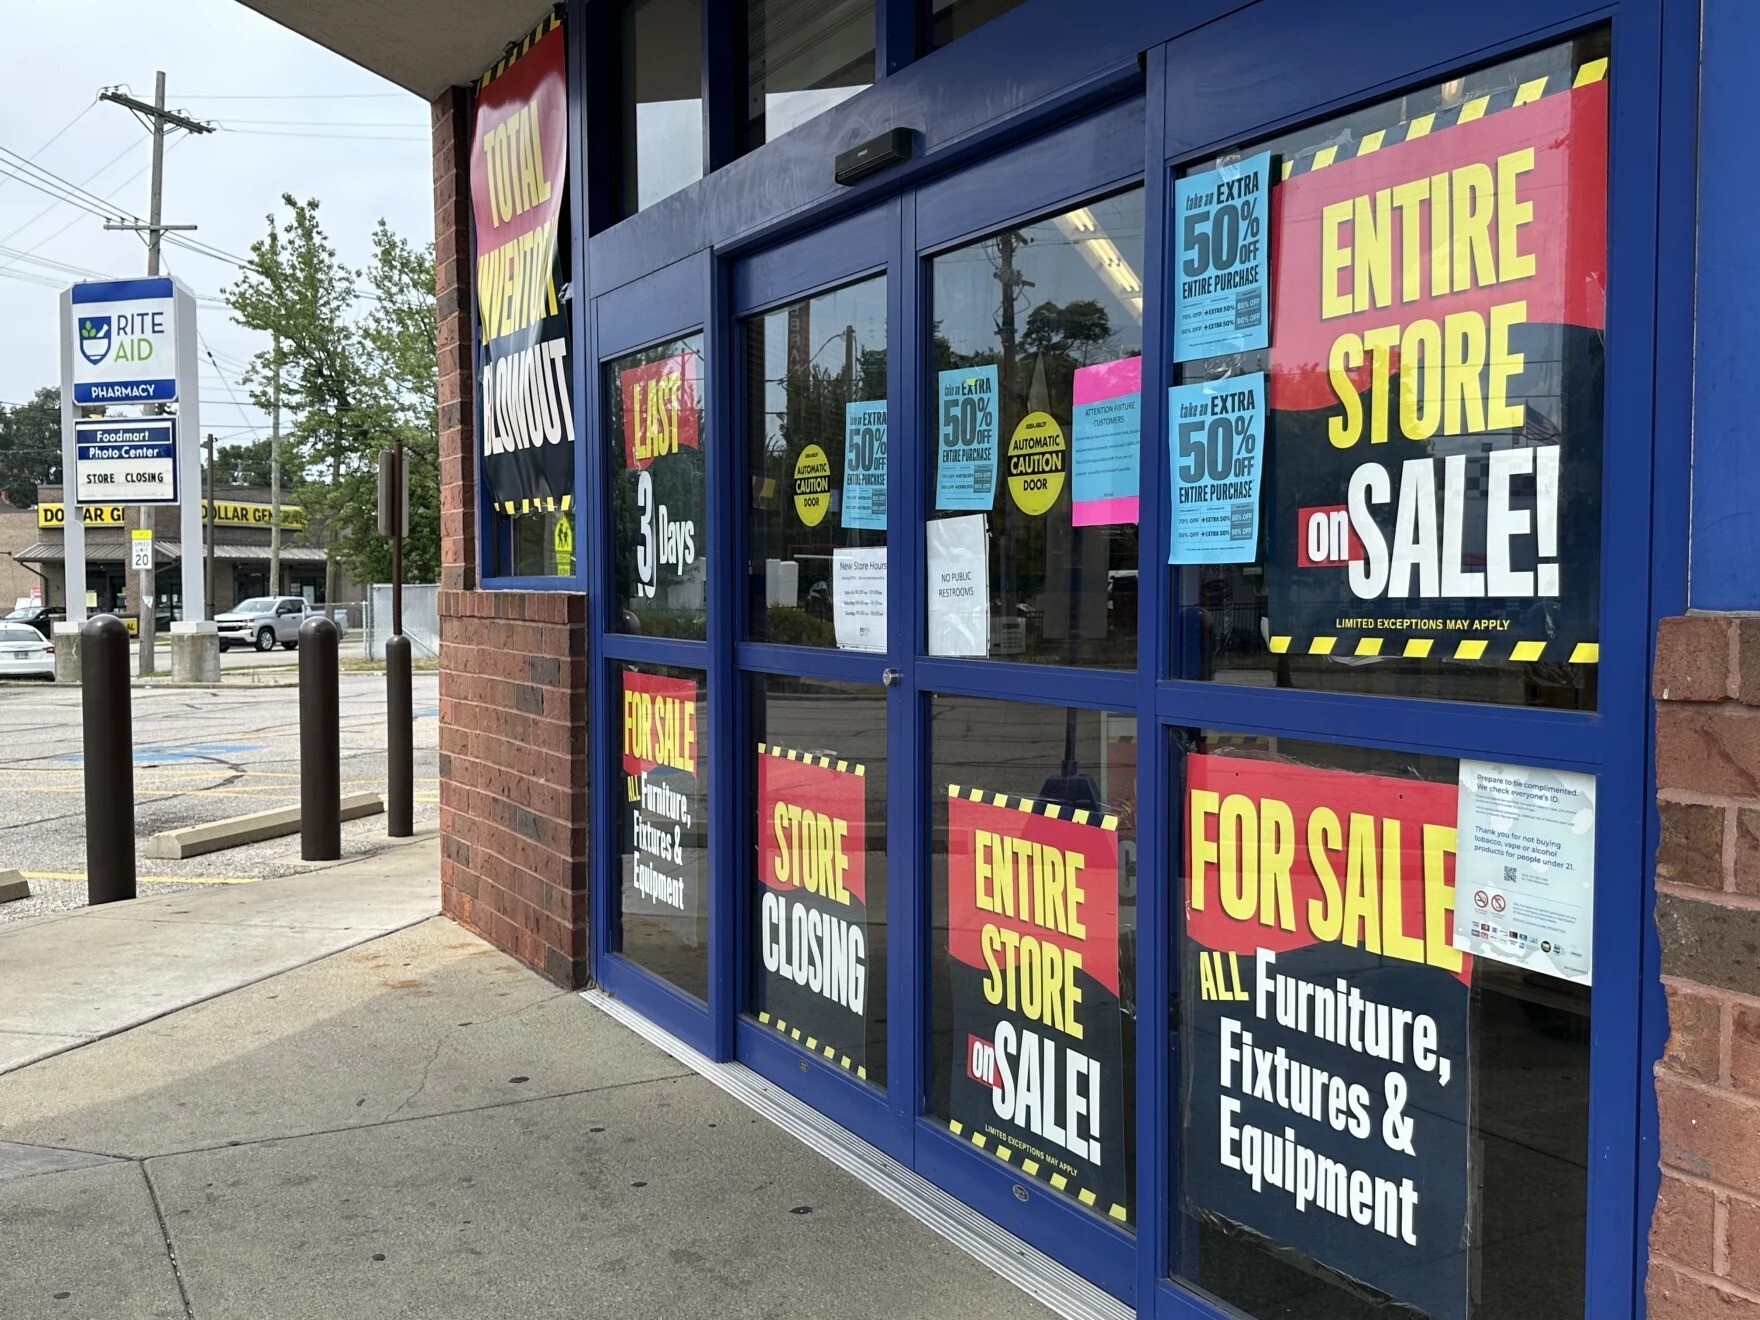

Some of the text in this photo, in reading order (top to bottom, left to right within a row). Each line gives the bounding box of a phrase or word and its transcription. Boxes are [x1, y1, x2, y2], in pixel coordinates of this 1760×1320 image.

[484, 99, 551, 229] TOTAL
[1186, 171, 1259, 211] take an EXTRA
[1183, 197, 1260, 277] 50%
[1321, 146, 1536, 319] ENTIRE
[1239, 239, 1260, 265] OFF
[1182, 276, 1212, 300] ENTIRE
[117, 312, 164, 336] RITE
[114, 338, 153, 362] AID
[1328, 300, 1527, 449] STORE
[91, 384, 155, 398] PHARMACY
[483, 337, 575, 457] BLOWOUT
[961, 378, 991, 396] EXTRA
[633, 372, 681, 460] LAST
[1085, 402, 1135, 416] ATTENTION FIXTURE
[1180, 389, 1255, 419] take an EXTRA
[863, 411, 887, 427] EXTRA
[943, 397, 992, 447] 50%
[1093, 416, 1124, 427] CUSTOMERS
[96, 430, 149, 442] Foodmart
[977, 429, 992, 445] OFF
[1013, 434, 1060, 451] AUTOMATIC
[89, 446, 159, 459] Photo Center
[847, 427, 887, 472] 50%
[943, 449, 961, 463] ENTIRE
[1178, 414, 1256, 483] 50%
[797, 462, 827, 475] AUTOMATIC
[873, 457, 886, 471] OFF
[1010, 452, 1062, 475] CAUTION
[1234, 456, 1255, 478] OFF
[86, 472, 164, 484] STORE CLOSING
[795, 477, 828, 494] CAUTION
[1023, 478, 1047, 491] DOOR
[804, 497, 819, 507] DOOR
[1179, 484, 1208, 504] ENTIRE
[43, 507, 104, 523] DOAR
[637, 471, 653, 583] 3
[1308, 445, 1560, 599] on SALE!
[658, 504, 695, 576] Days
[135, 554, 149, 566] 20
[840, 560, 887, 571] New Store Hours
[941, 571, 972, 583] NO PUBLIC
[938, 587, 974, 598] RESTROOMS
[1336, 618, 1510, 631] LIMITED EXCEPTIONS MAY APPLY
[624, 690, 694, 773] FOR SALE
[1476, 783, 1488, 791] We
[1489, 785, 1510, 795] check
[1511, 789, 1549, 801] everyone's
[1477, 773, 1504, 785] Prepare
[1513, 779, 1523, 787] be
[1524, 782, 1578, 797] complimented.
[627, 771, 692, 829] ALL Furniture,
[633, 809, 683, 866] Fixtures &
[1474, 835, 1503, 848] tobacco,
[1504, 841, 1521, 850] vape
[1531, 846, 1558, 858] alcohol
[1475, 825, 1561, 850] Thank you for not buying
[774, 801, 850, 906] STORE
[1474, 845, 1504, 856] products
[1505, 849, 1515, 858] for
[1516, 854, 1542, 864] people
[1542, 858, 1564, 869] under
[633, 850, 684, 911] Equipment
[974, 829, 1086, 941] ENTIRE
[1190, 788, 1463, 973] FOR SALE
[762, 891, 866, 1016] CLOSING
[980, 923, 1083, 1041] STORE
[1199, 947, 1451, 1088] ALL Furniture,
[972, 1020, 1101, 1167] on SALE!
[1219, 1017, 1416, 1158] Fixtures &
[984, 1123, 1078, 1177] LIMITED EXCEPTIONS MAY APPLY
[1219, 1095, 1418, 1247] Equipment
